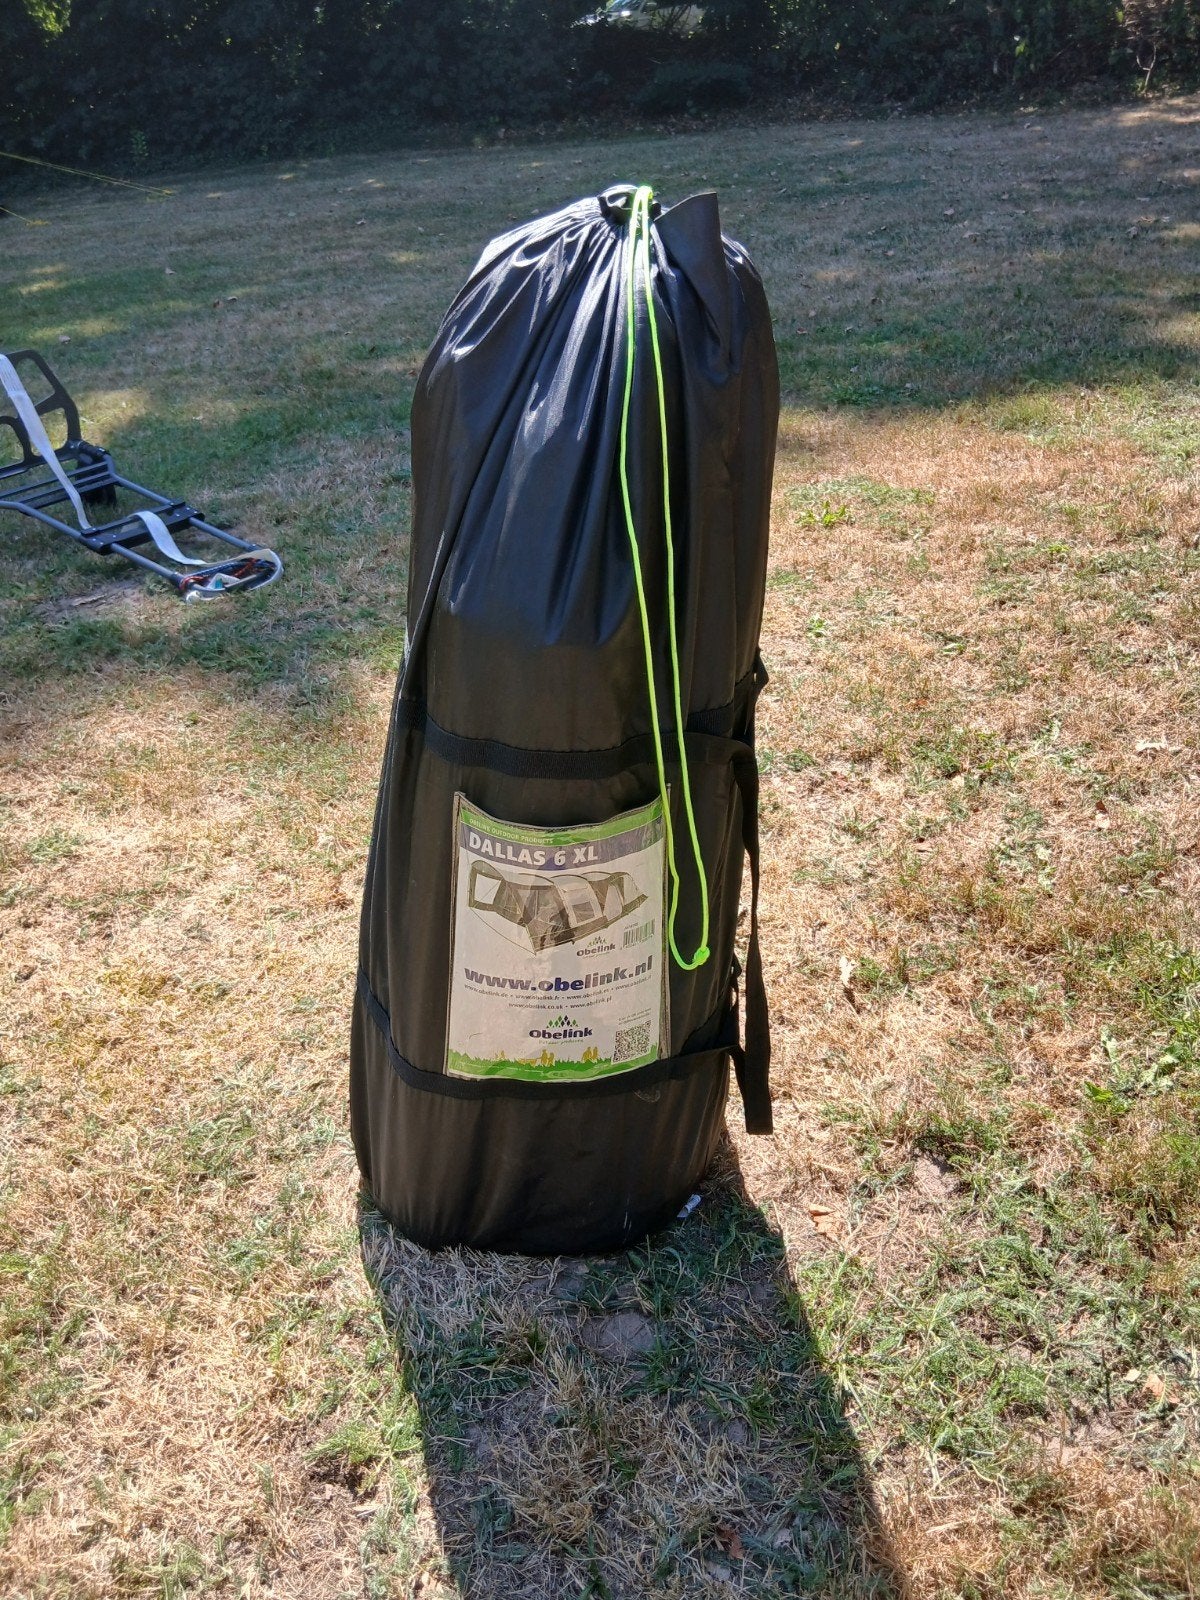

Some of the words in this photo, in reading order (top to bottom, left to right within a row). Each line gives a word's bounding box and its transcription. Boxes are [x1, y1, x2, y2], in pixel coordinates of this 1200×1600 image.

[491, 826, 520, 840] OUTDOOR
[521, 835, 554, 844] PRODUCTS
[469, 831, 546, 866] DALLAS
[554, 850, 566, 866] 6
[572, 847, 599, 865] XL
[576, 943, 616, 957] Obelink
[464, 955, 653, 991] www.obelink.nl
[529, 1027, 593, 1039] Obelink
